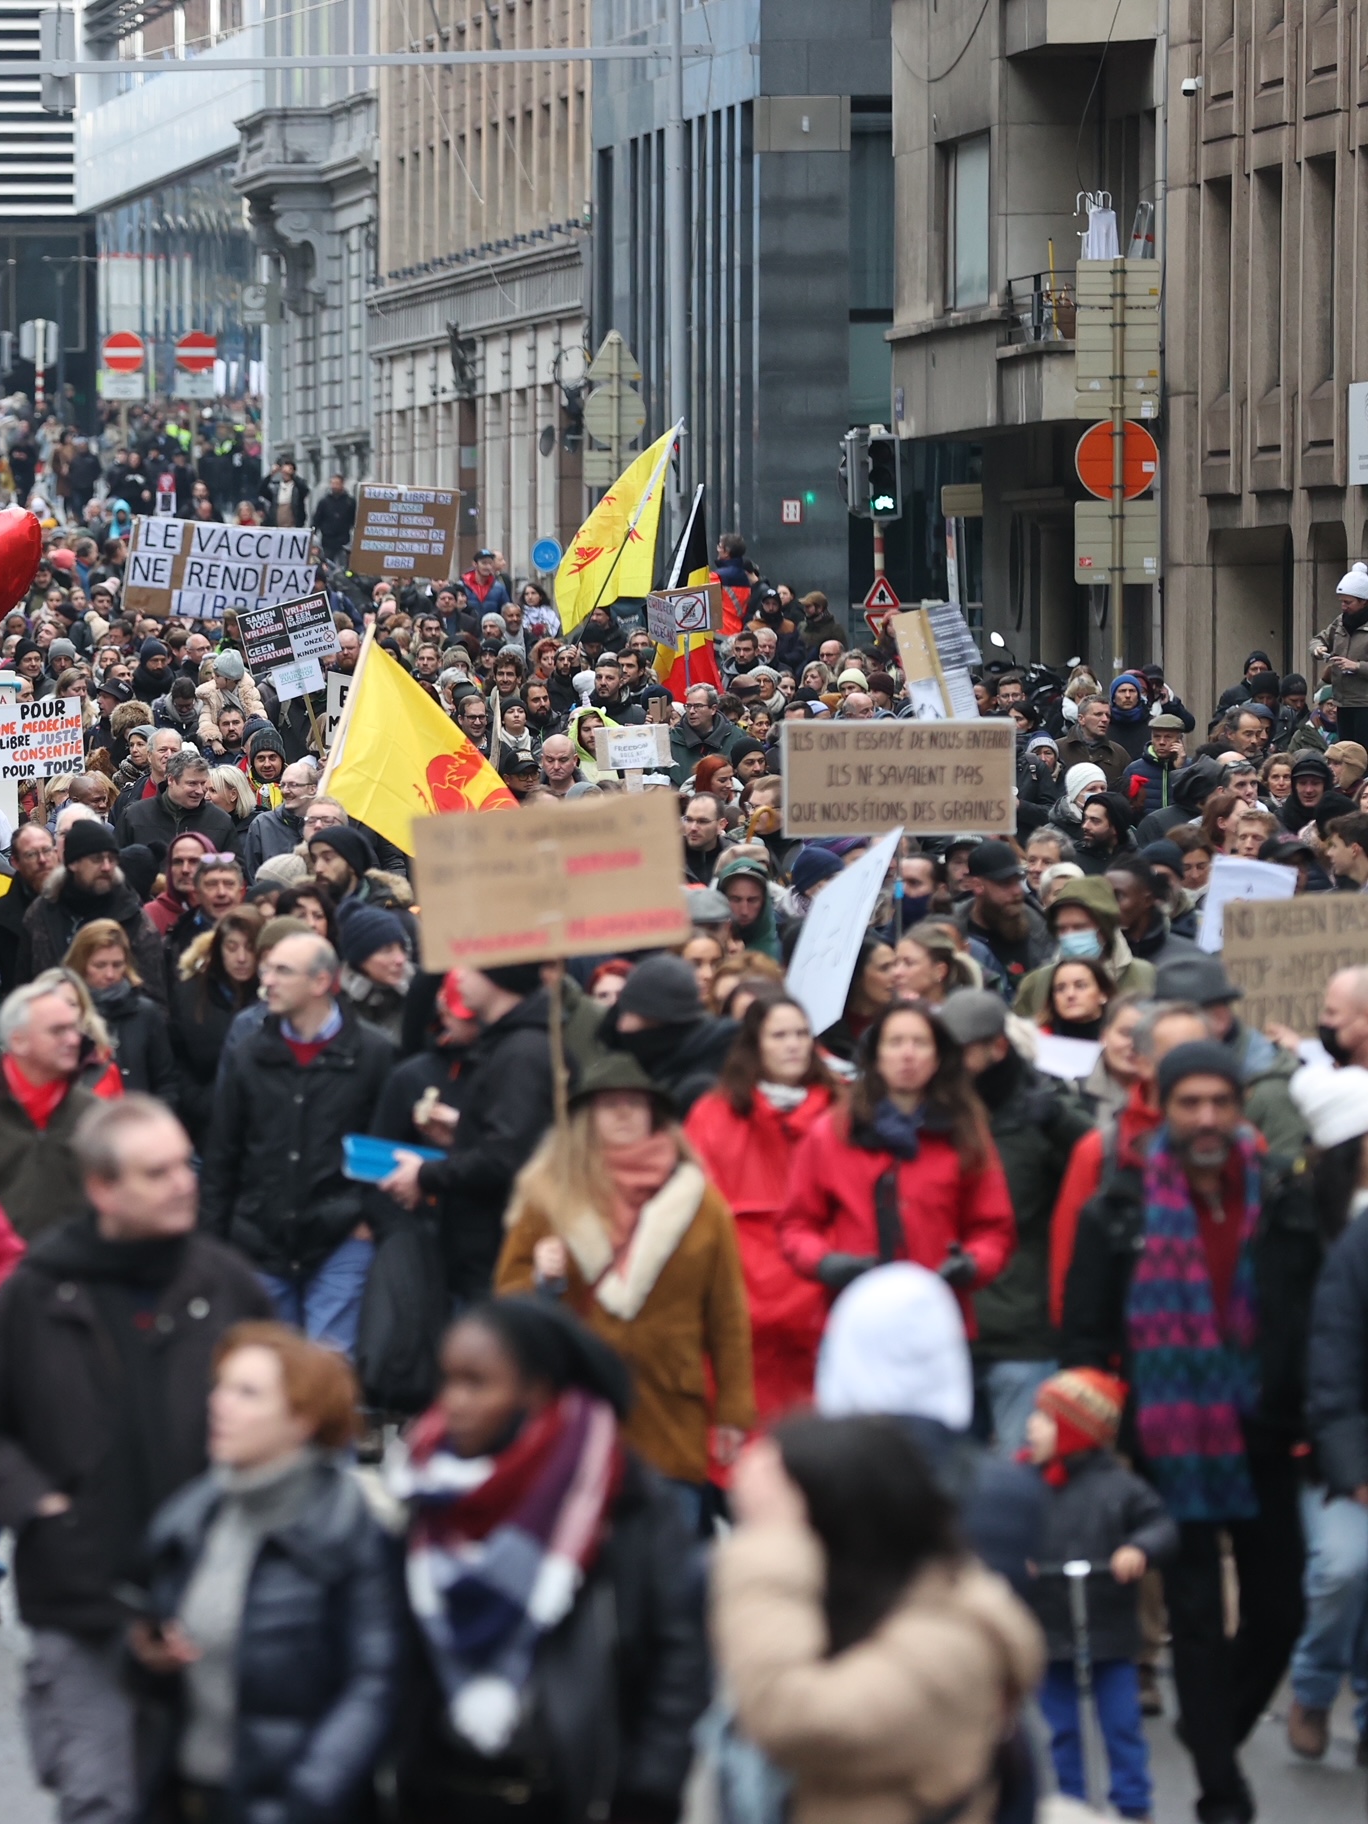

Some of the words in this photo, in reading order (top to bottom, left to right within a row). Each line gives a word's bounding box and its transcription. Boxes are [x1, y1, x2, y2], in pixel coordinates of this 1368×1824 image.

[368, 488, 380, 497] TU
[384, 490, 394, 498] ES
[404, 492, 431, 501] LIBRE
[439, 494, 450, 503] DE
[393, 504, 423, 513] PENSER
[145, 522, 178, 549] LE
[197, 526, 308, 559] VACCIN
[431, 530, 444, 540] DE
[363, 541, 394, 551] PENSER
[398, 542, 414, 552] QUE
[418, 544, 428, 552] TU
[386, 558, 413, 568] LIBRE
[132, 556, 168, 582] NE
[187, 562, 260, 592] REND
[268, 569, 314, 594] PAS
[284, 599, 323, 616] VRIJHEID
[296, 610, 311, 620] EEN
[245, 610, 276, 624] SAMEN
[249, 618, 274, 630] VOOR
[288, 612, 326, 628] BASISRECHT
[245, 623, 283, 639] VRIJHEID
[293, 631, 312, 640] BLIJF
[314, 626, 329, 634] VAN
[304, 637, 323, 646] ONZE
[248, 643, 275, 657] GEEN
[250, 648, 292, 664] DICTATUUR
[297, 644, 335, 658] KINDEREN!
[20, 700, 66, 720] POUR
[37, 729, 79, 745] JUSTE
[791, 731, 813, 751] ILS
[820, 731, 849, 750] ONT
[856, 727, 905, 749] ESSAYÉ
[910, 731, 927, 749] DE
[930, 730, 963, 750] NOUS
[614, 742, 648, 751] FREEDOM
[2, 764, 35, 778] POUR
[43, 756, 83, 775] TOUS
[826, 764, 852, 787] ILS
[877, 765, 947, 786] SAVAIENT
[953, 766, 984, 785] PAS
[791, 802, 818, 823] QUE
[821, 802, 859, 822] NOUS
[861, 797, 908, 822] ÉTIONS
[912, 801, 934, 821] DES
[942, 800, 1006, 822] GRAINES
[1333, 898, 1368, 934] PAS
